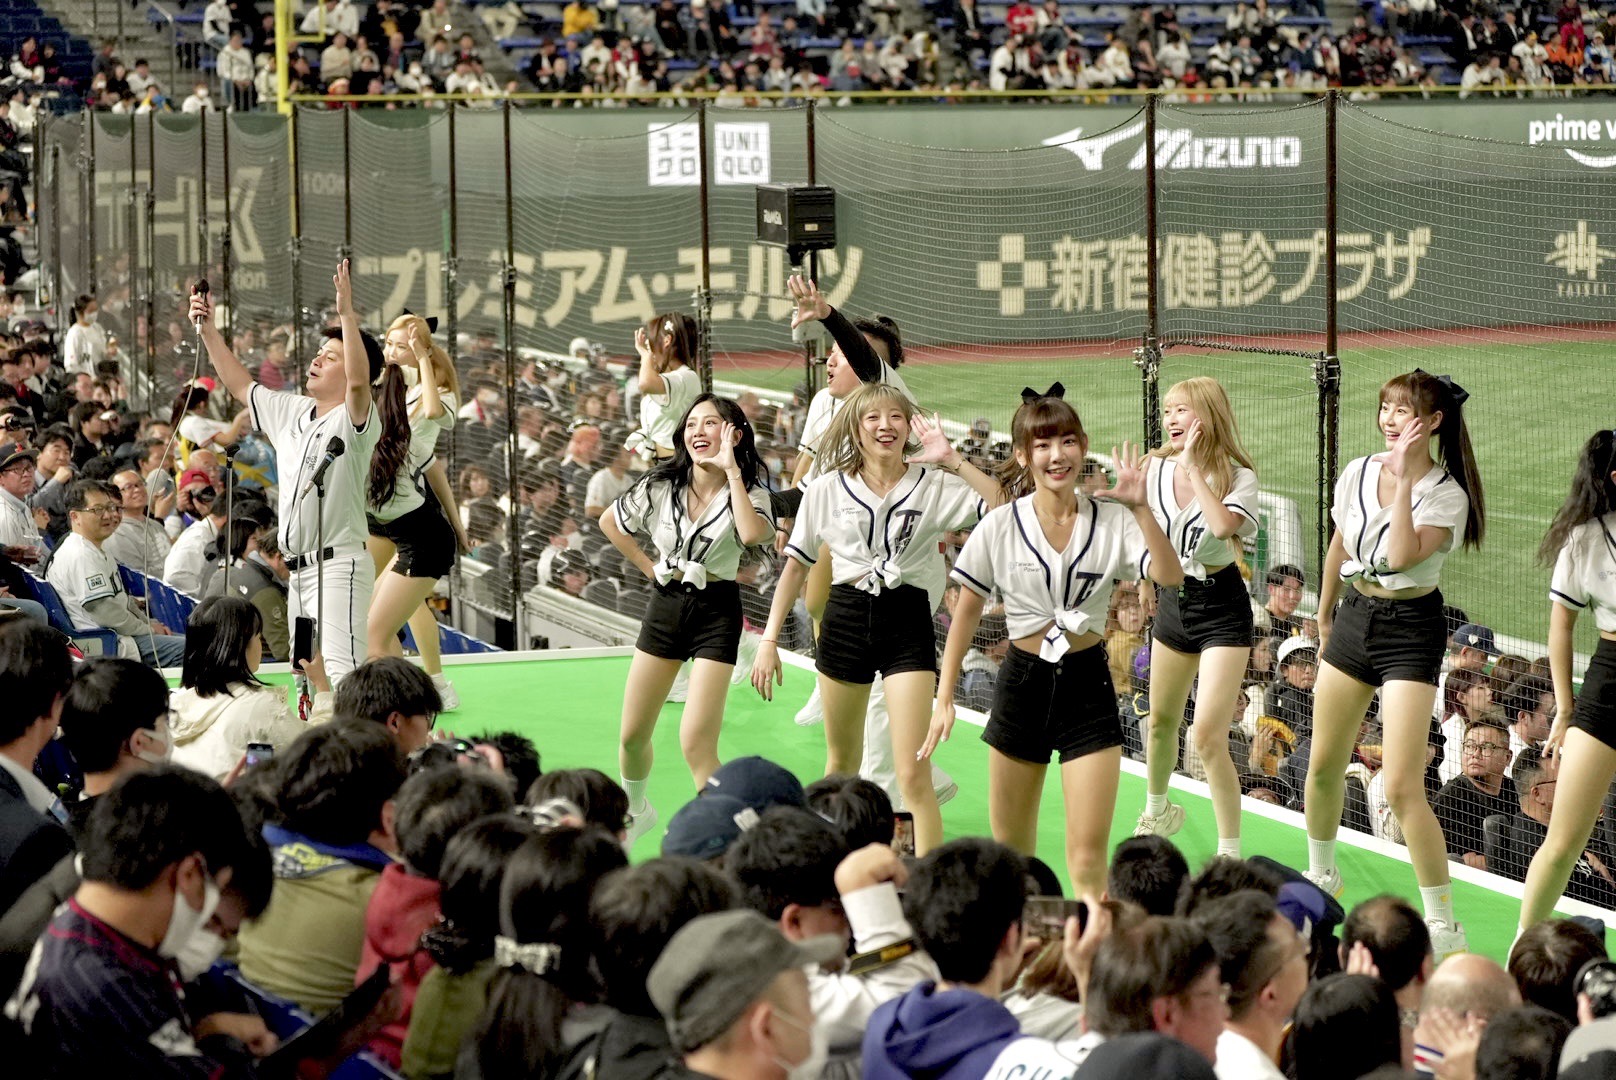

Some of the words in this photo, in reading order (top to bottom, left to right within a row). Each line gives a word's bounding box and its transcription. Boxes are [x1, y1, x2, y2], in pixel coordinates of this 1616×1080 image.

[722, 131, 760, 152] UNI
[1529, 113, 1601, 145] prime
[721, 155, 763, 179] QLO
[95, 166, 265, 269] THK
[1050, 226, 1432, 313] 新宿健診プラザ
